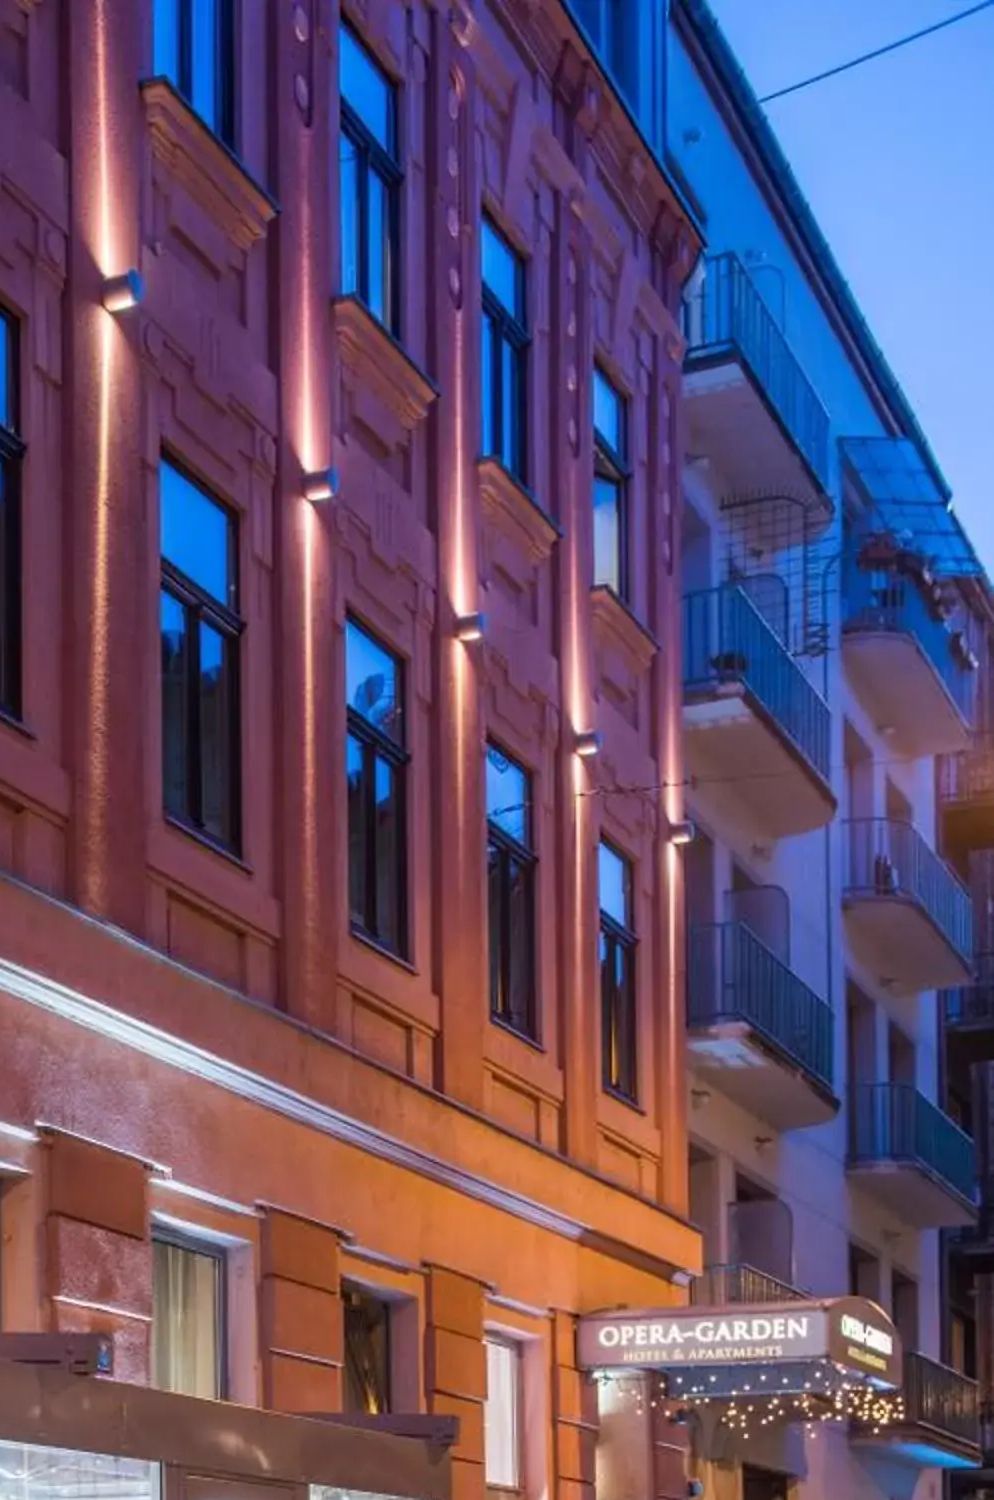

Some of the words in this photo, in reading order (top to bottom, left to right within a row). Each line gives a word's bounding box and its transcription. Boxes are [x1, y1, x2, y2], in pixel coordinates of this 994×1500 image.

[599, 1318, 808, 1347] OPERA-GARDEN
[623, 1349, 669, 1362] HOTEL
[688, 1346, 783, 1360] APARTMENTS
